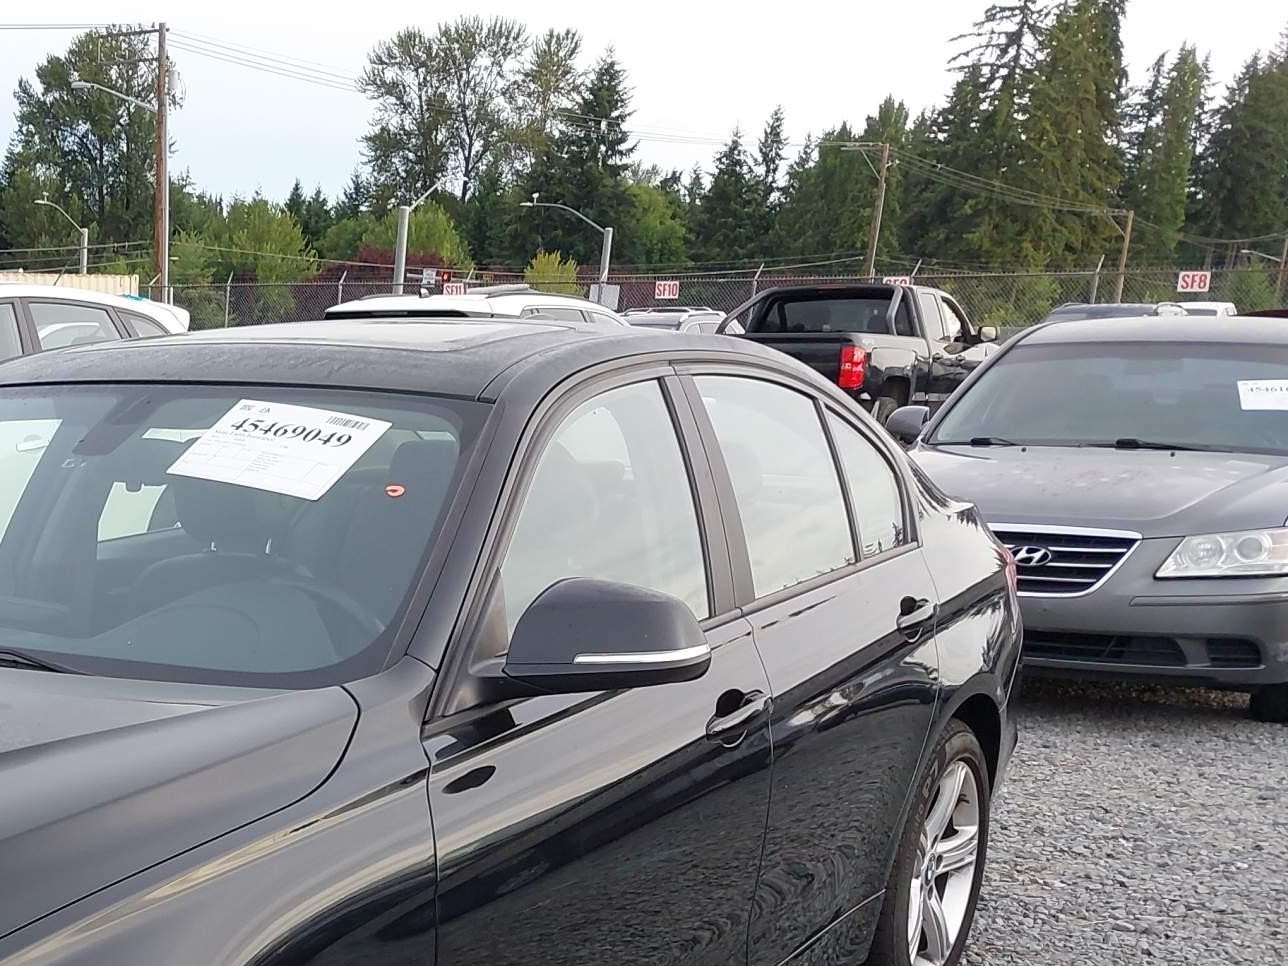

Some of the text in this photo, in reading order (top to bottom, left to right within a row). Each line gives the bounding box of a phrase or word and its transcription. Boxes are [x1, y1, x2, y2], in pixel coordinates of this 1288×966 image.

[656, 283, 679, 297] SF10
[1180, 273, 1208, 290] SF8
[230, 417, 353, 448] 45469049
